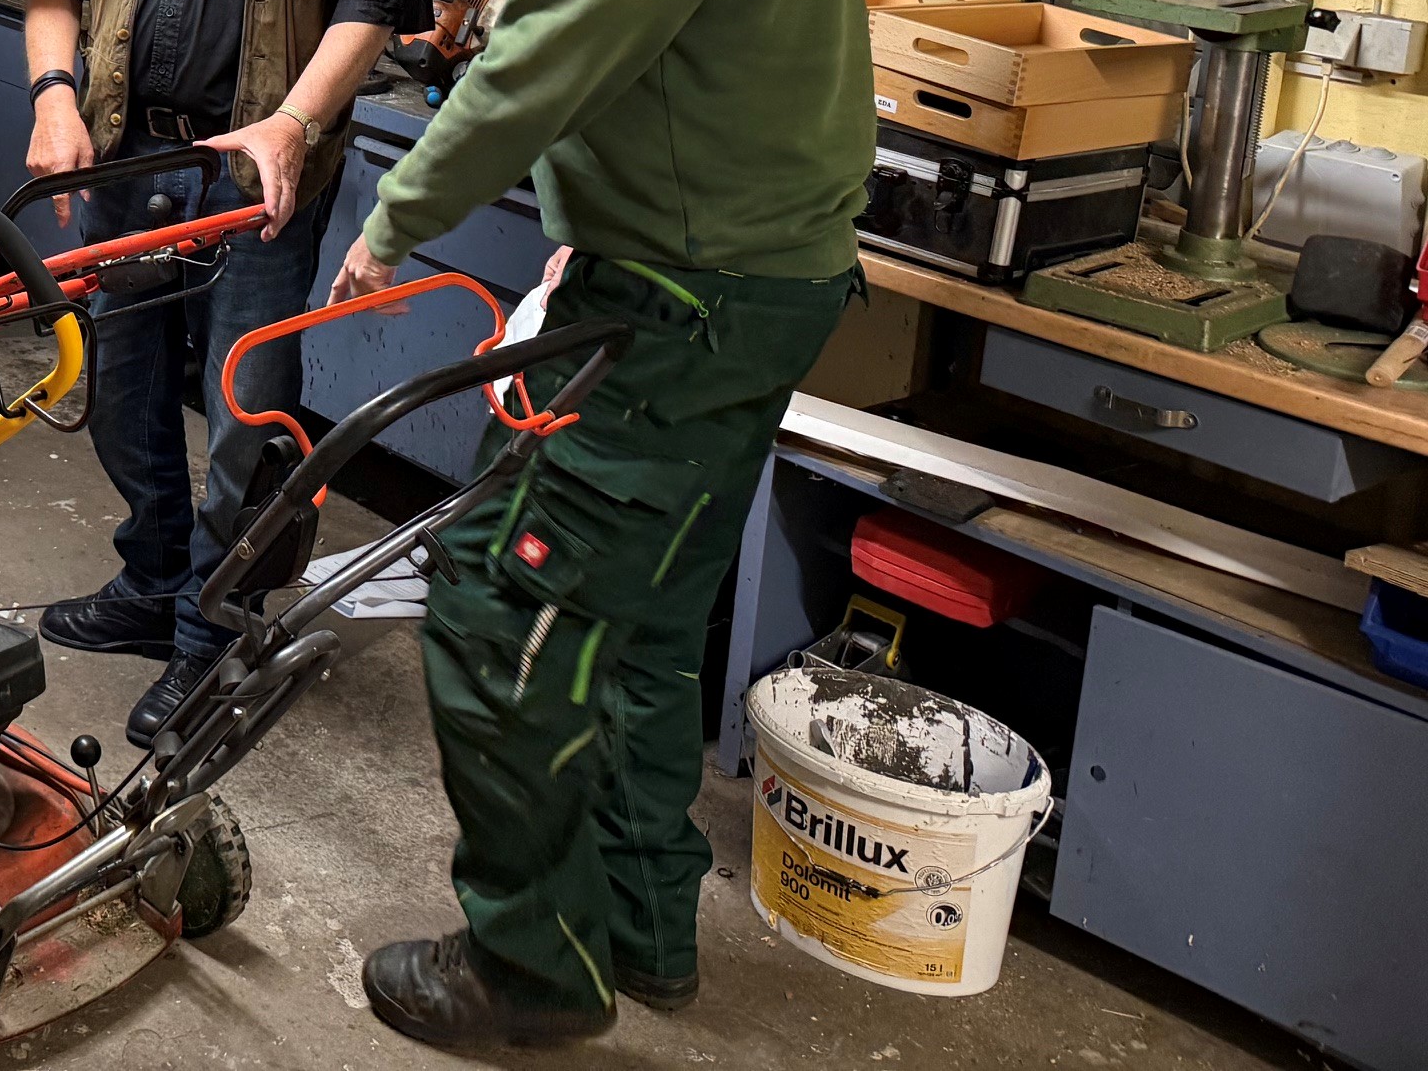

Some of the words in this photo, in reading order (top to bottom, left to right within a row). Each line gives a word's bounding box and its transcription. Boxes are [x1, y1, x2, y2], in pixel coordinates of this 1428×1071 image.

[785, 790, 910, 874] Brillux
[780, 870, 810, 901] 900
[782, 850, 852, 903] Dolomit
[925, 963, 936, 972] 15
